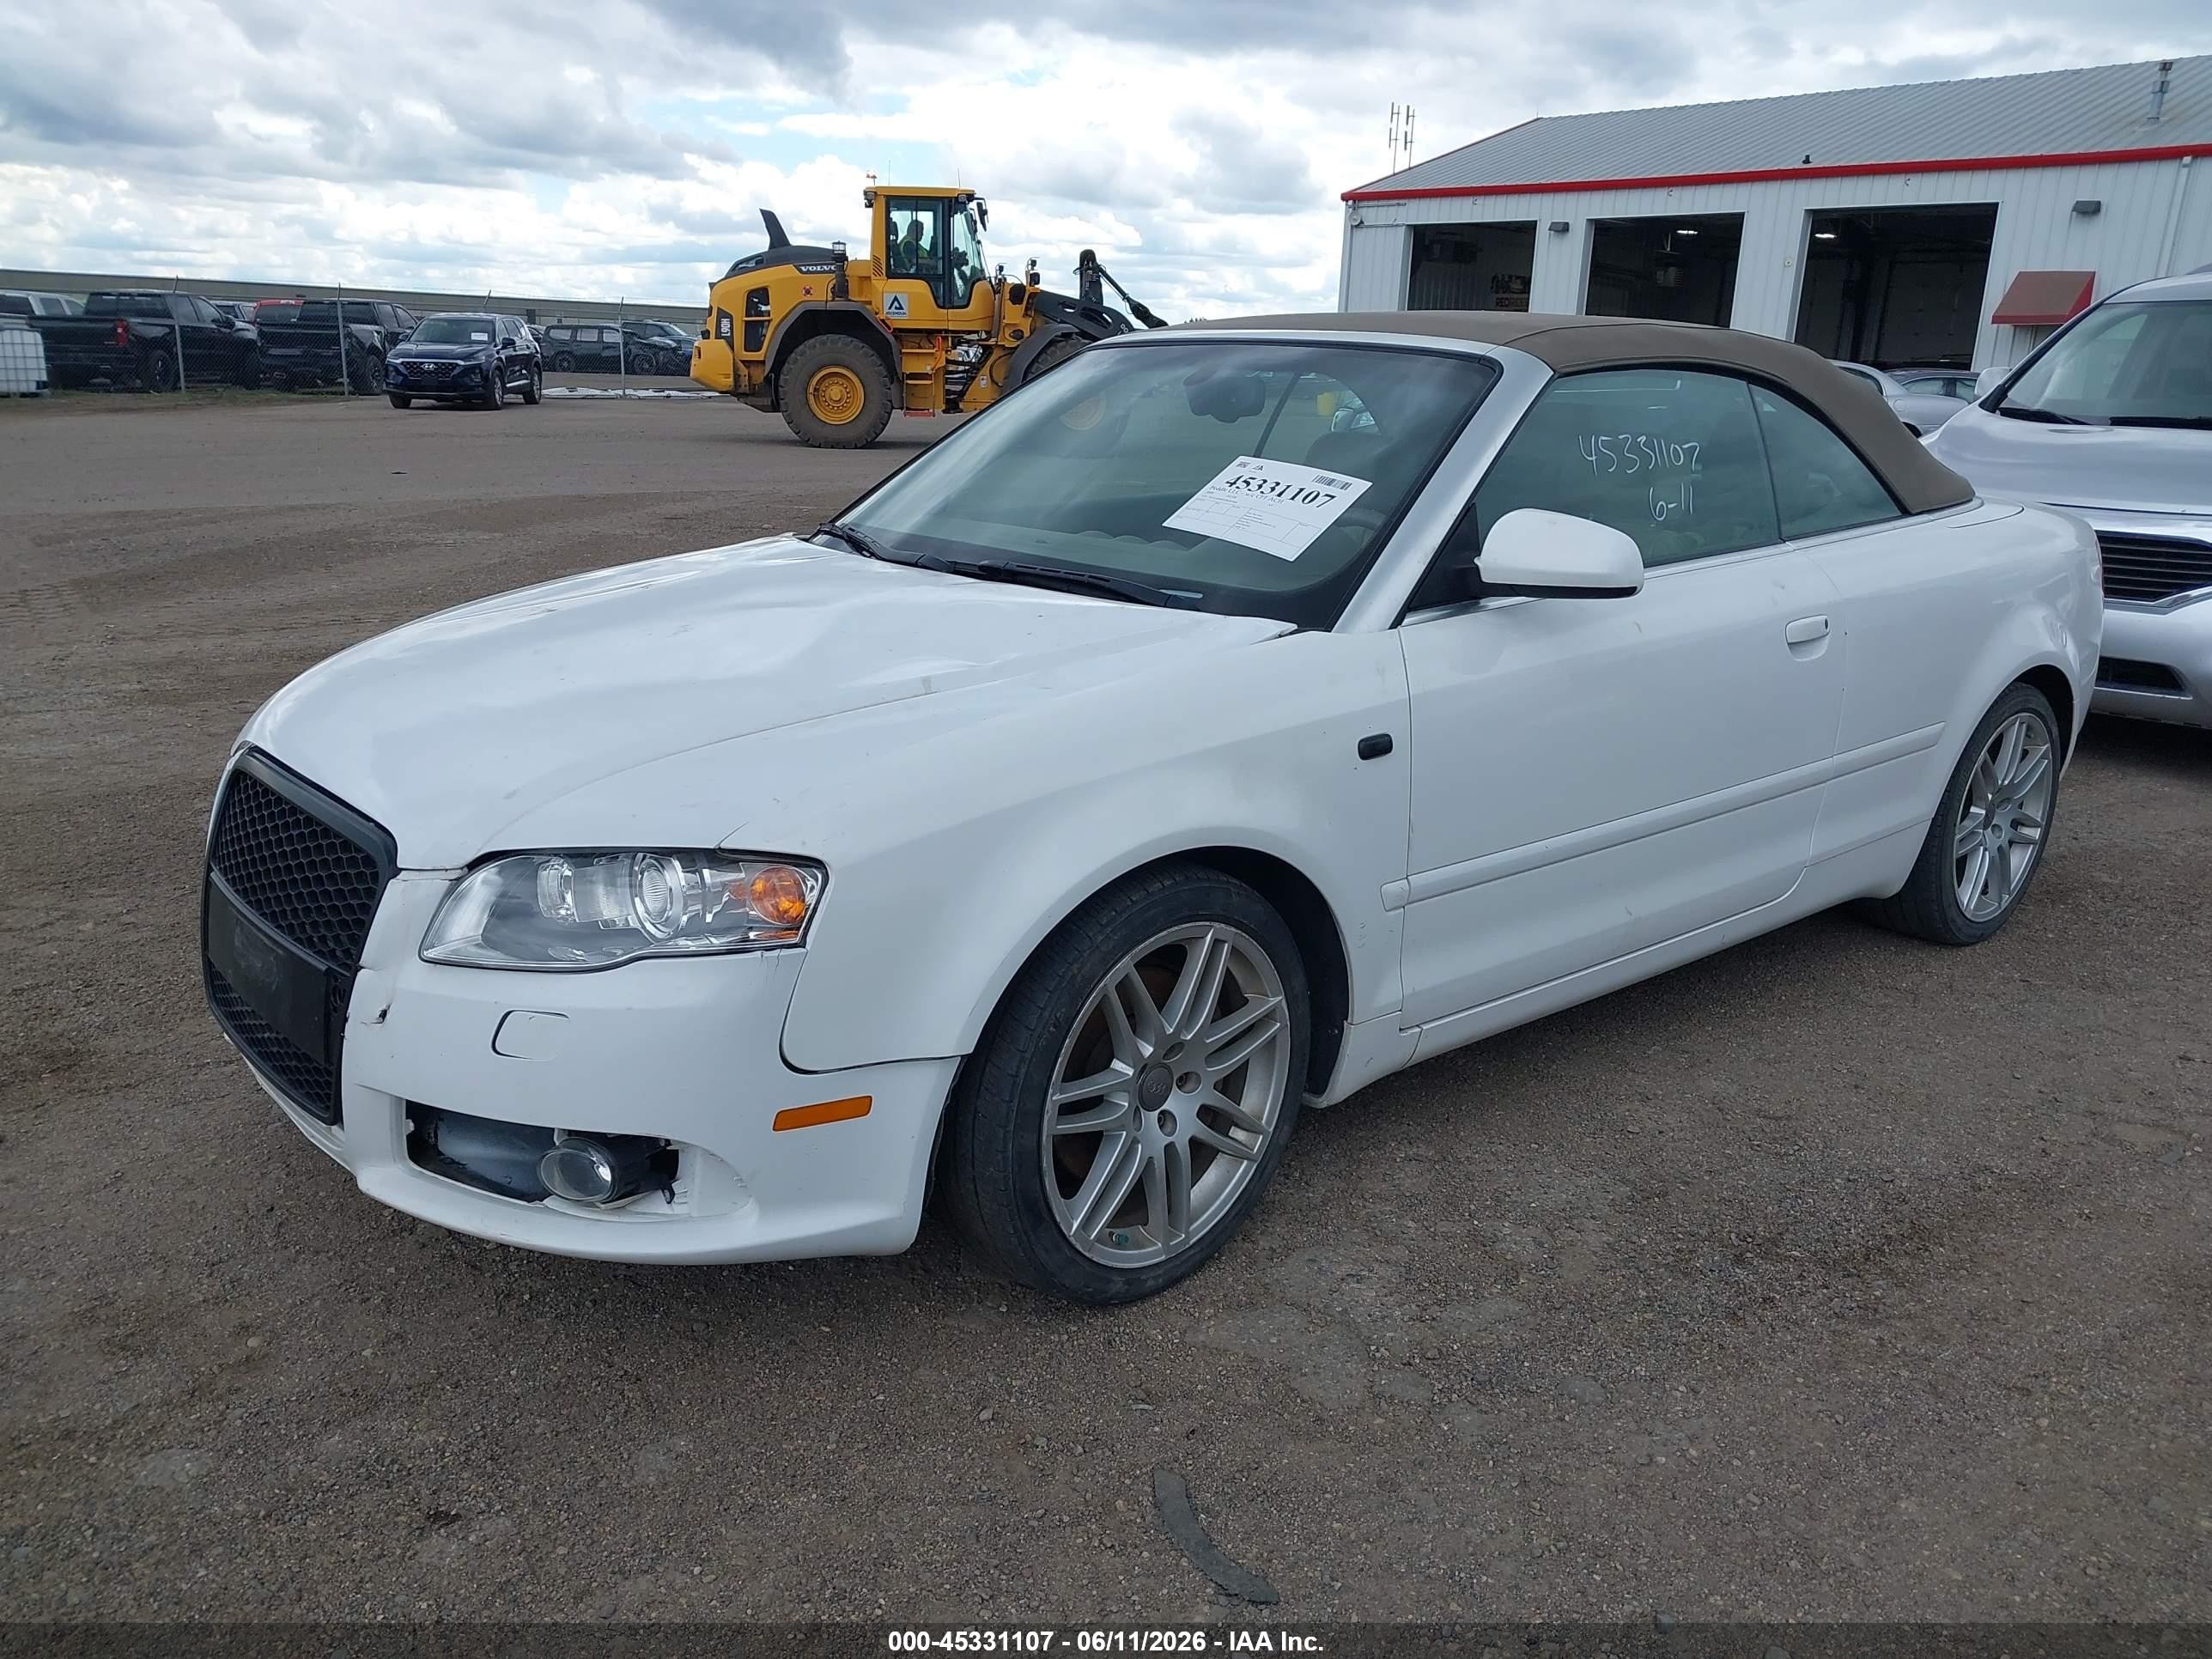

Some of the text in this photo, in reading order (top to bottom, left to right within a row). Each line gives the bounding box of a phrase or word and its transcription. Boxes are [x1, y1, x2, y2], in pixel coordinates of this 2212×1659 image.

[1578, 434, 1699, 475] 45331107
[1225, 474, 1337, 507] 45331107
[1649, 483, 1693, 520] 6-11
